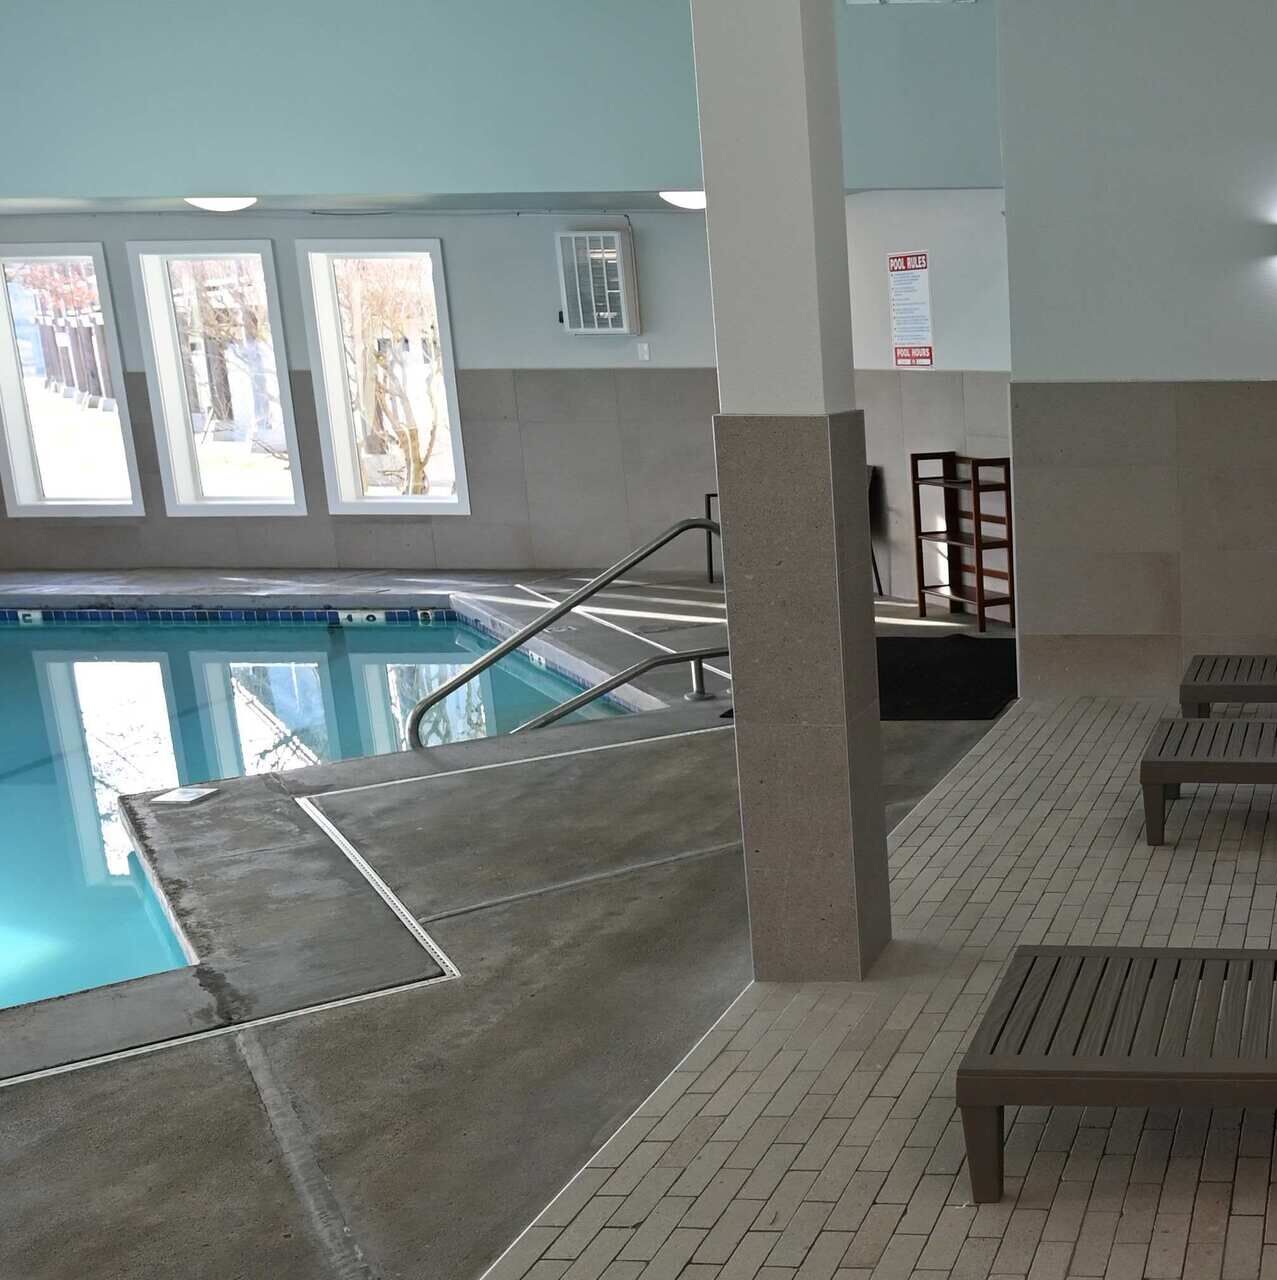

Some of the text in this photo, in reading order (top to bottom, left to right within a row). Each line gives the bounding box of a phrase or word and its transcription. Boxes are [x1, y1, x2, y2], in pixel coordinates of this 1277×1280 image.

[890, 256, 926, 270] POOL RULES
[897, 348, 911, 358] POOL
